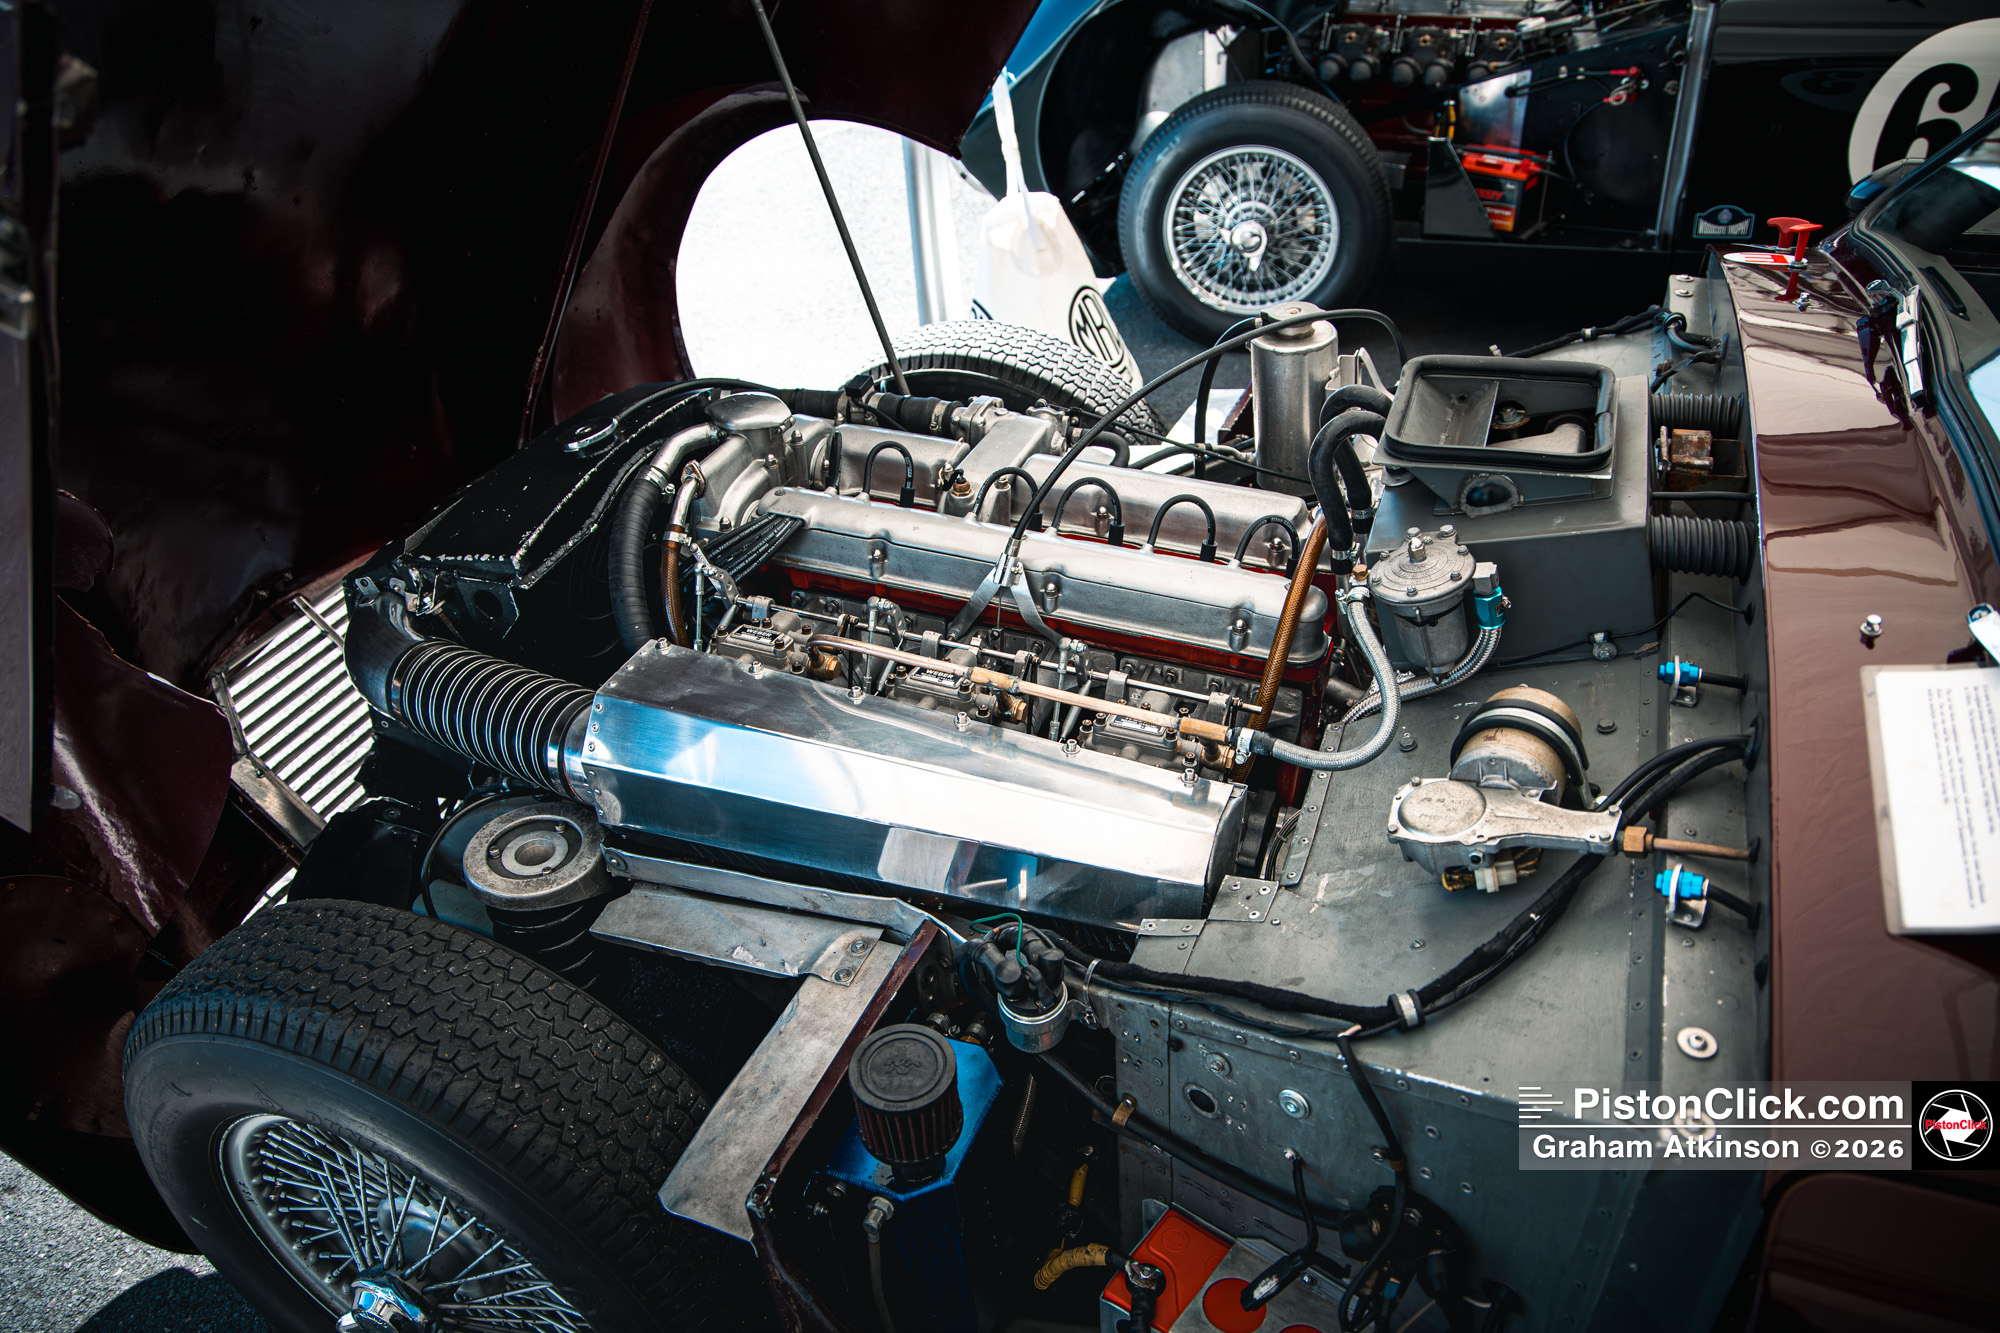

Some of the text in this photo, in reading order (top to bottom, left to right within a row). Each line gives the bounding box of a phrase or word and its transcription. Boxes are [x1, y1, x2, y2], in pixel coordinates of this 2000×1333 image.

[1873, 62, 2000, 172] 6
[746, 627, 773, 638] WEBER
[925, 668, 955, 680] WEBER
